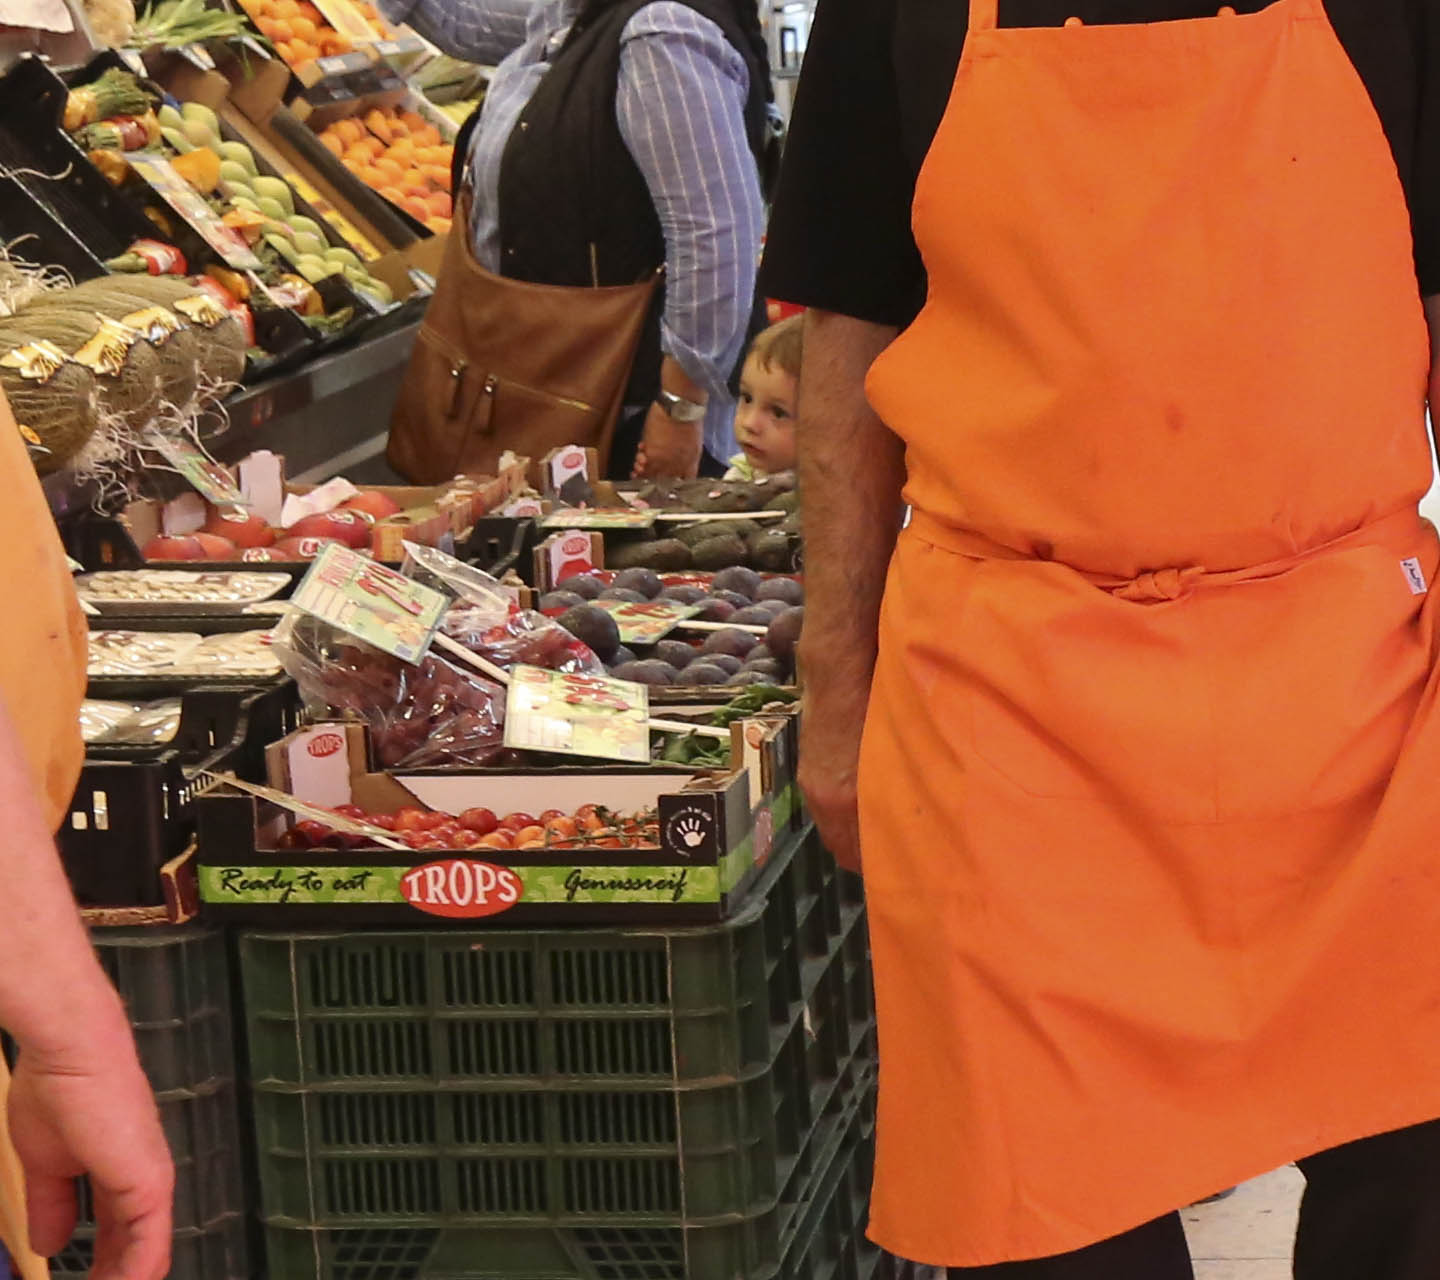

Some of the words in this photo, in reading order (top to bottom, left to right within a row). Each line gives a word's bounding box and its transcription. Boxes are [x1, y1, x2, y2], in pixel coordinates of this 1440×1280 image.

[220, 868, 297, 904] Ready
[300, 871, 324, 891] to
[333, 869, 368, 891] eat
[563, 868, 689, 902] Genussreif
[406, 861, 519, 908] TROPS
